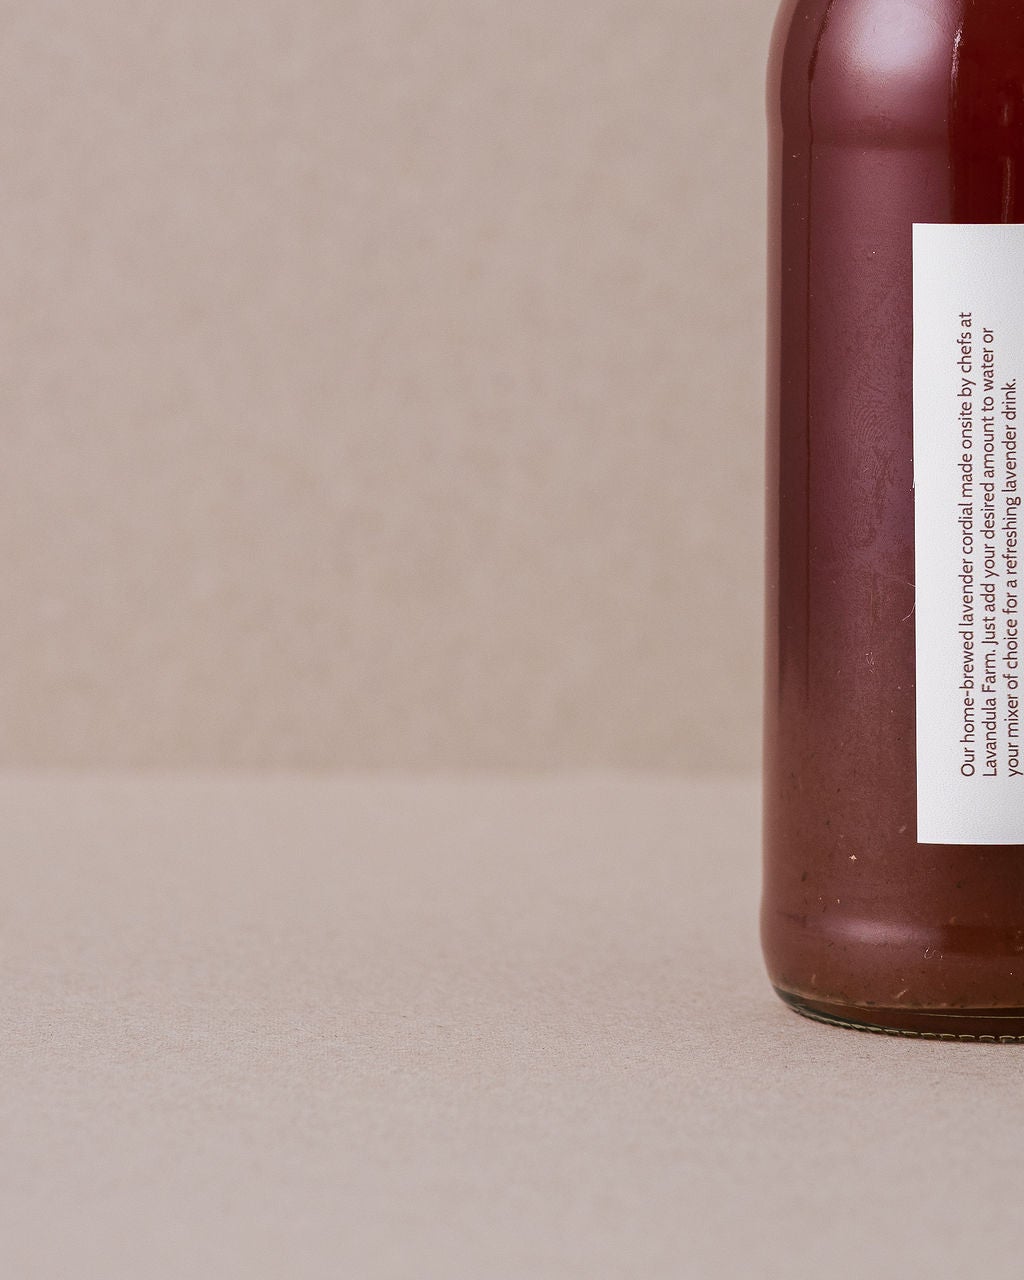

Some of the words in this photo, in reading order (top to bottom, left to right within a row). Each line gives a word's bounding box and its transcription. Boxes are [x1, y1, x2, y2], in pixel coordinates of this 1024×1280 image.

[958, 311, 972, 328] at
[982, 327, 994, 344] or
[956, 331, 973, 374] chefs
[980, 347, 995, 392] water
[956, 377, 977, 397] by
[980, 396, 995, 413] to
[1000, 378, 1017, 421] drink.
[957, 401, 974, 450] onsite
[980, 415, 995, 479] amount
[956, 453, 973, 498] made
[1000, 424, 1018, 493] lavender
[957, 501, 974, 555] cordial
[978, 482, 996, 540] desired
[1001, 496, 1022, 575] refreshing
[983, 543, 1000, 579] your
[957, 557, 975, 627] lavender
[979, 583, 996, 613] add
[1001, 591, 1018, 615] for
[1006, 579, 1018, 589] a
[980, 615, 1000, 646] Just
[1001, 618, 1019, 670] choice
[957, 630, 976, 743] home-brewed
[981, 649, 997, 693] Farm.
[1002, 673, 1019, 690] of
[980, 697, 998, 777] Lavandula
[1003, 693, 1020, 738] mixer
[960, 746, 976, 778] Our
[1007, 741, 1024, 778] your
